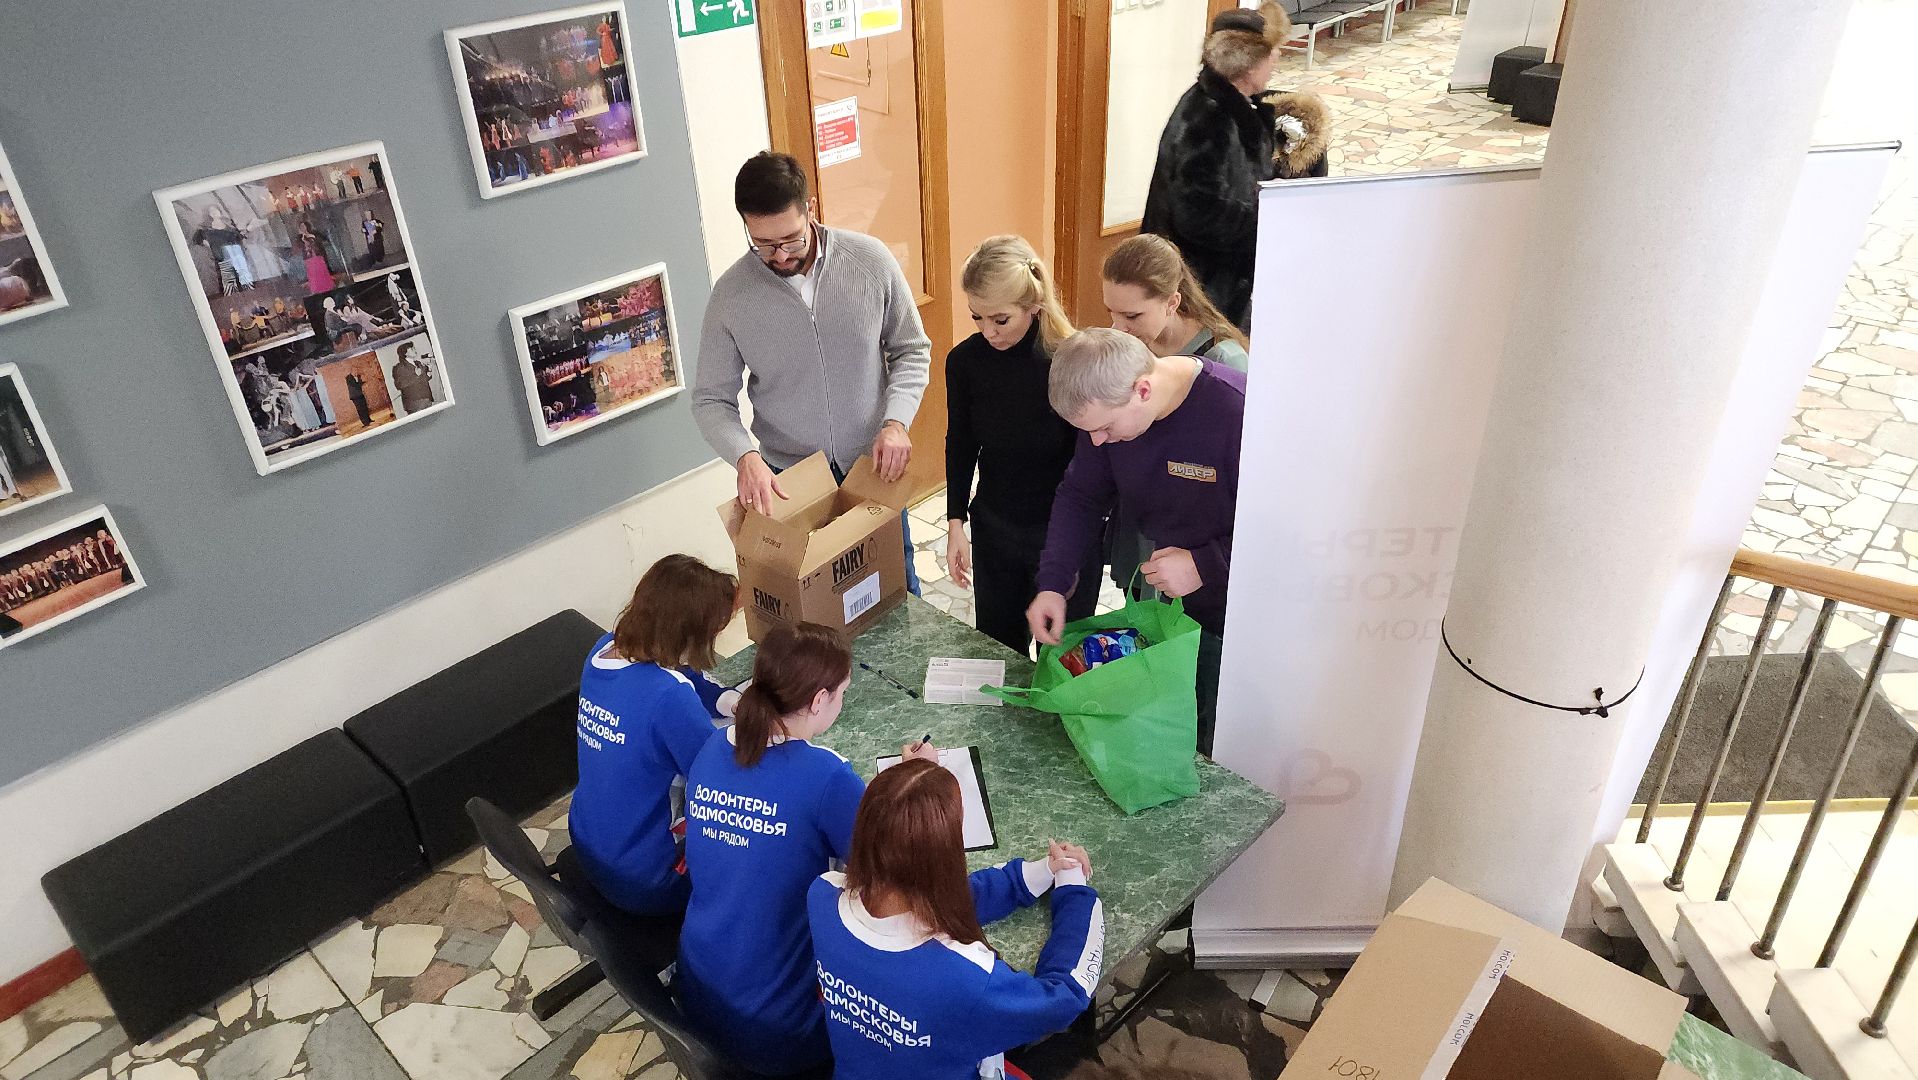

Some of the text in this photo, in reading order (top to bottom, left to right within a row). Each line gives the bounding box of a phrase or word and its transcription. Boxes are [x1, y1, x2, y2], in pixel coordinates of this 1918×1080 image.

[832, 543, 865, 585] FAIRY
[753, 587, 781, 616] FAIRY
[579, 697, 620, 727] ЛОНТЕРЫ
[695, 784, 778, 817] ВОЛОНТЕРЫ
[702, 827, 750, 849] МЫ РЯДОМ
[816, 959, 918, 1034] ВОЛОНТЕРЫ
[830, 1009, 893, 1052] МЫ РЯДОМ
